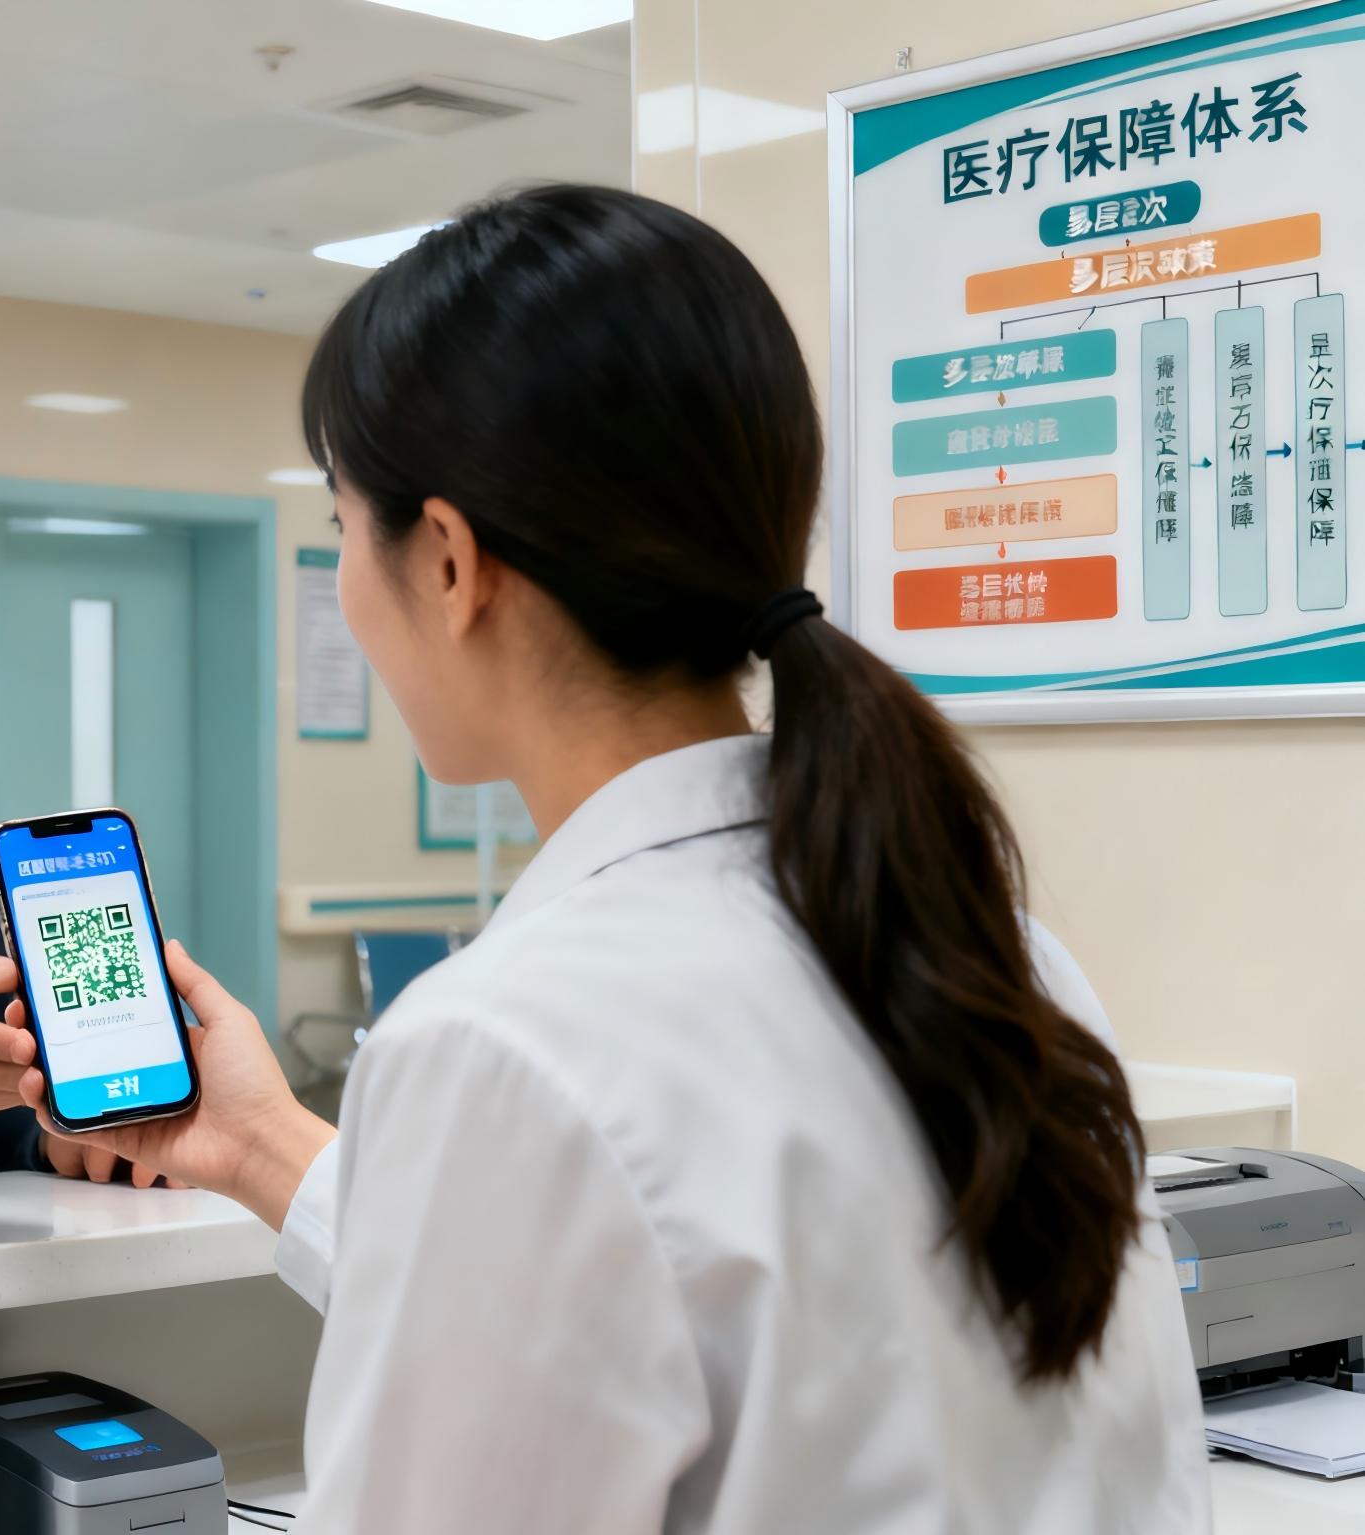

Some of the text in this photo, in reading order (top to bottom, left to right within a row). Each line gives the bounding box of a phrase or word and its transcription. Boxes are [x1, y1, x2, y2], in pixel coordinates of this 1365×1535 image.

[944, 72, 1308, 203] 医疗保障体系
